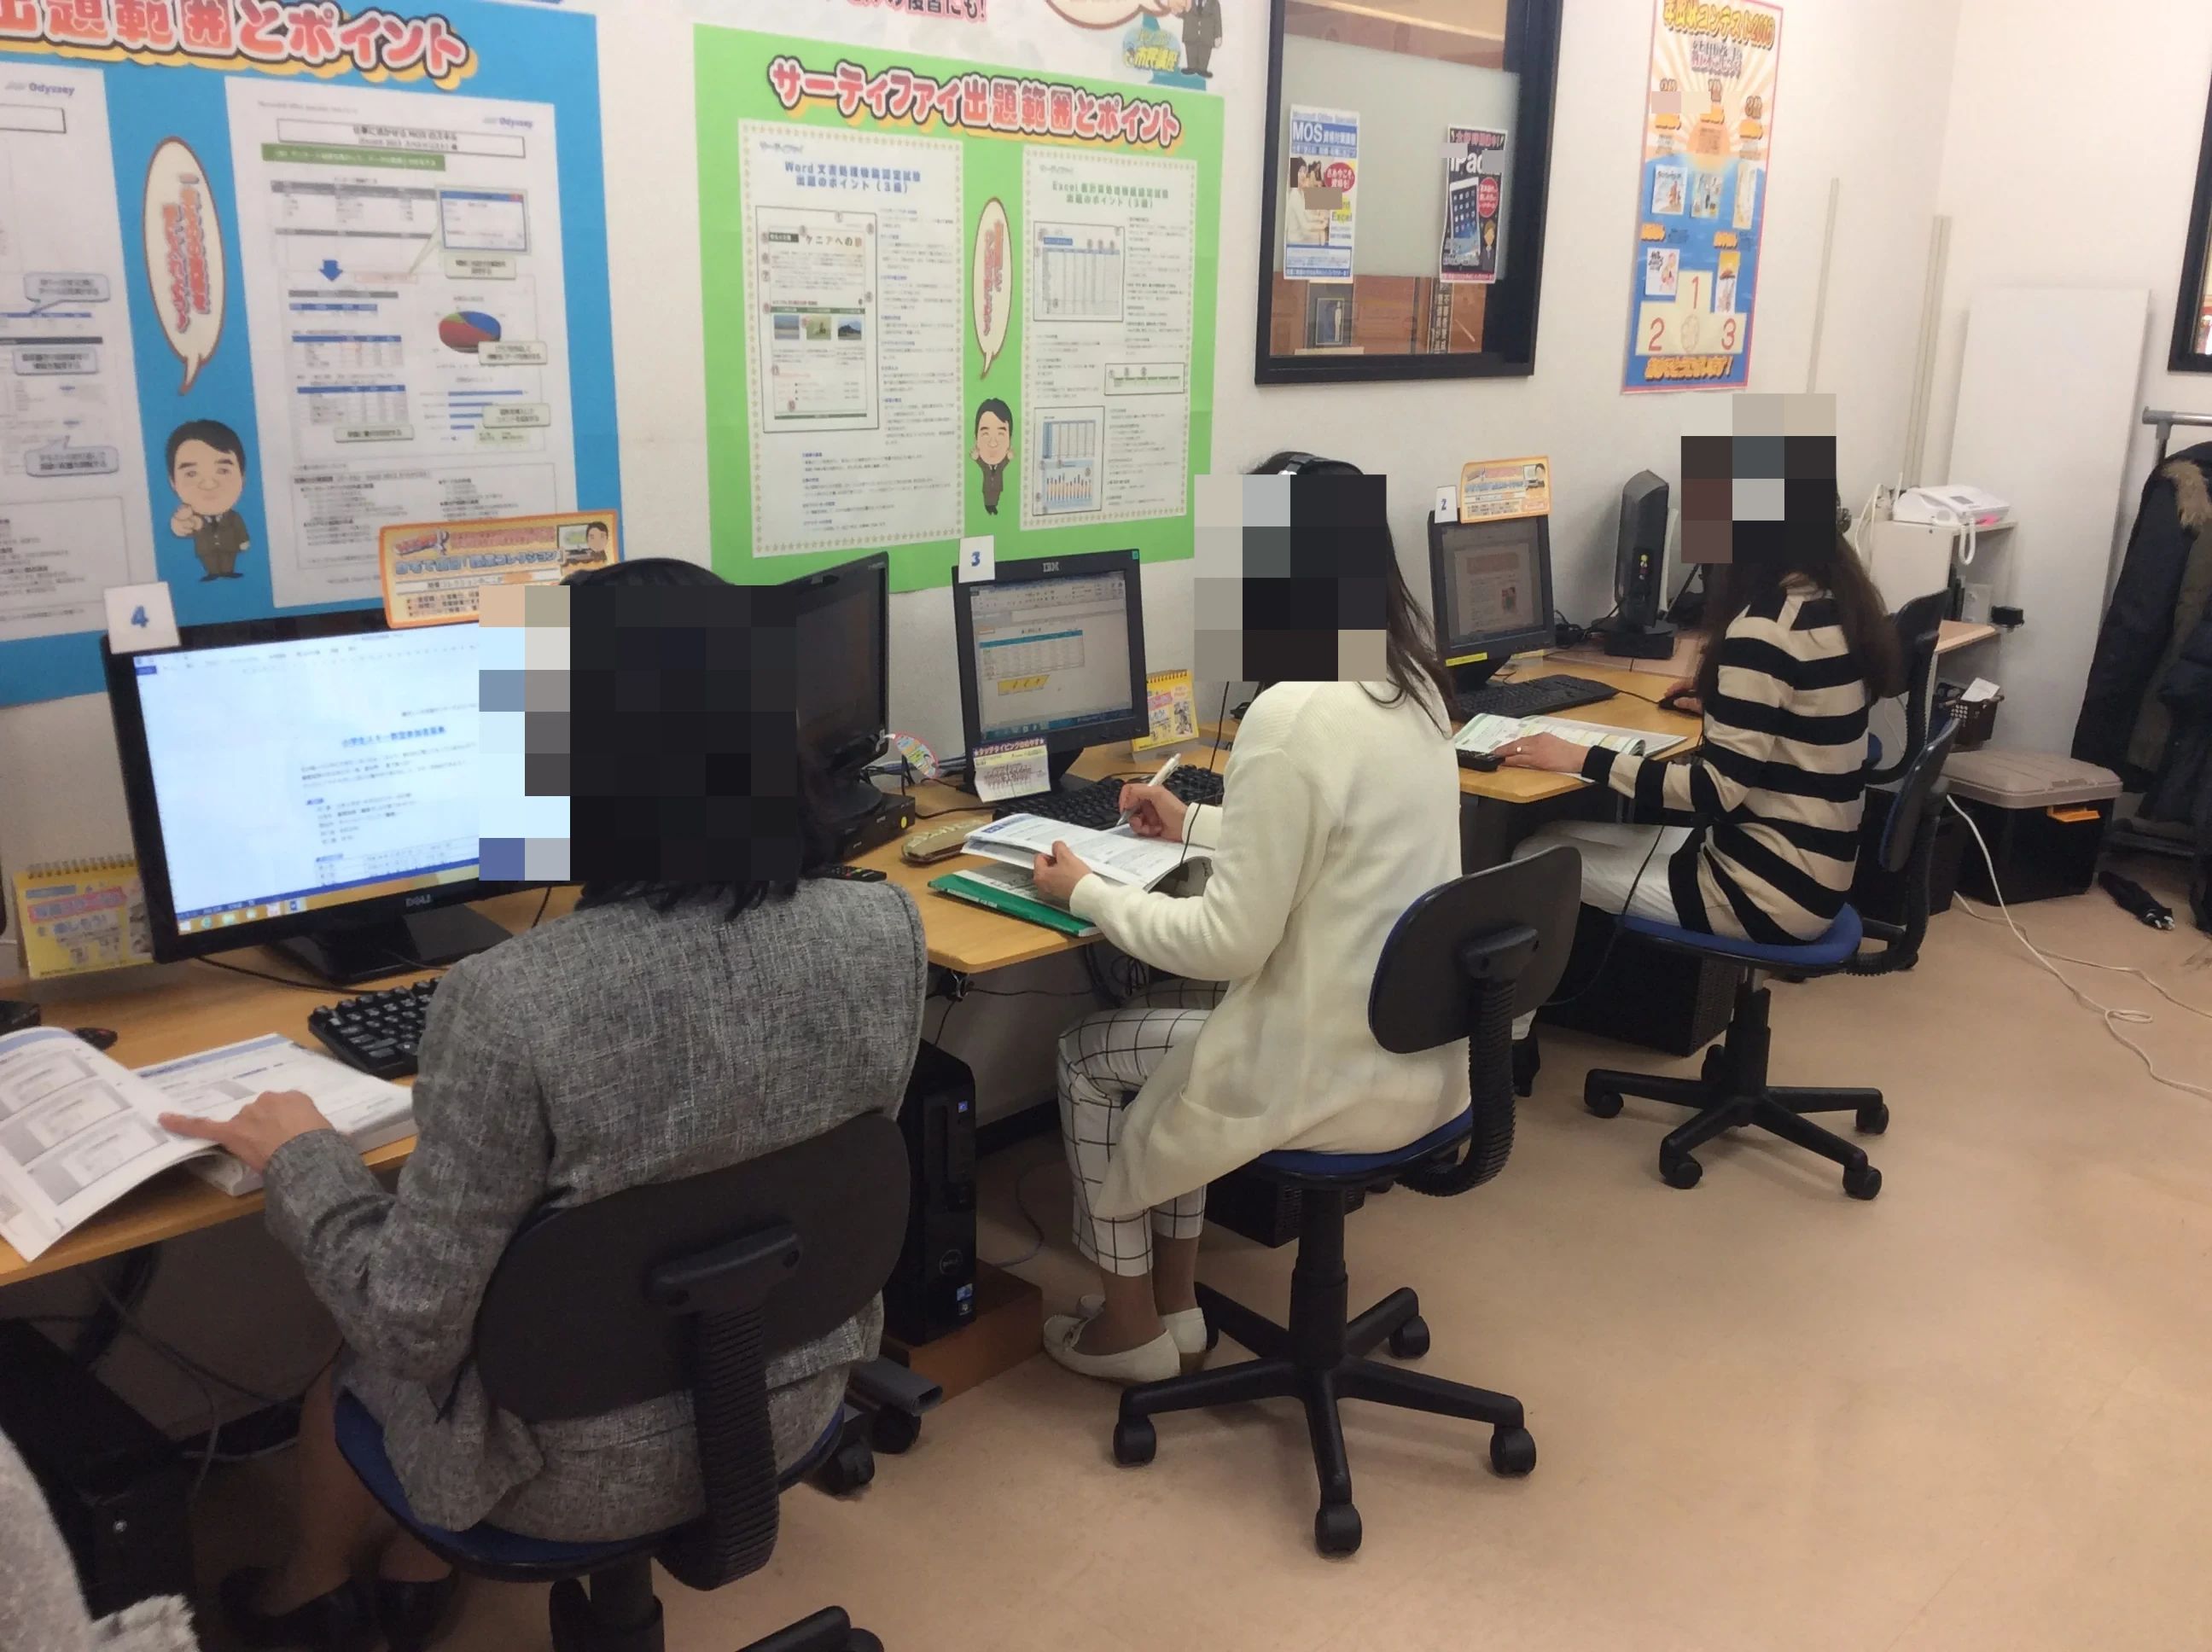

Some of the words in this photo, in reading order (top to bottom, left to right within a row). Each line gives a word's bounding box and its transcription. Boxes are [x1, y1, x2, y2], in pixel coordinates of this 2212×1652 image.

[28, 81, 75, 96] Odyssey
[771, 57, 1179, 147] サーティファイ出題範囲とポイント
[1292, 121, 1322, 143] MOS
[785, 160, 814, 173] Word
[1051, 180, 1079, 192] Excel
[1692, 275, 1699, 310] 1
[1648, 317, 1665, 352] 2
[1721, 317, 1737, 350] 3
[1441, 499, 1448, 511] 2
[970, 551, 981, 567] 3
[1042, 561, 1060, 573] IBM
[130, 605, 149, 629] 4
[405, 894, 433, 907] DELL
